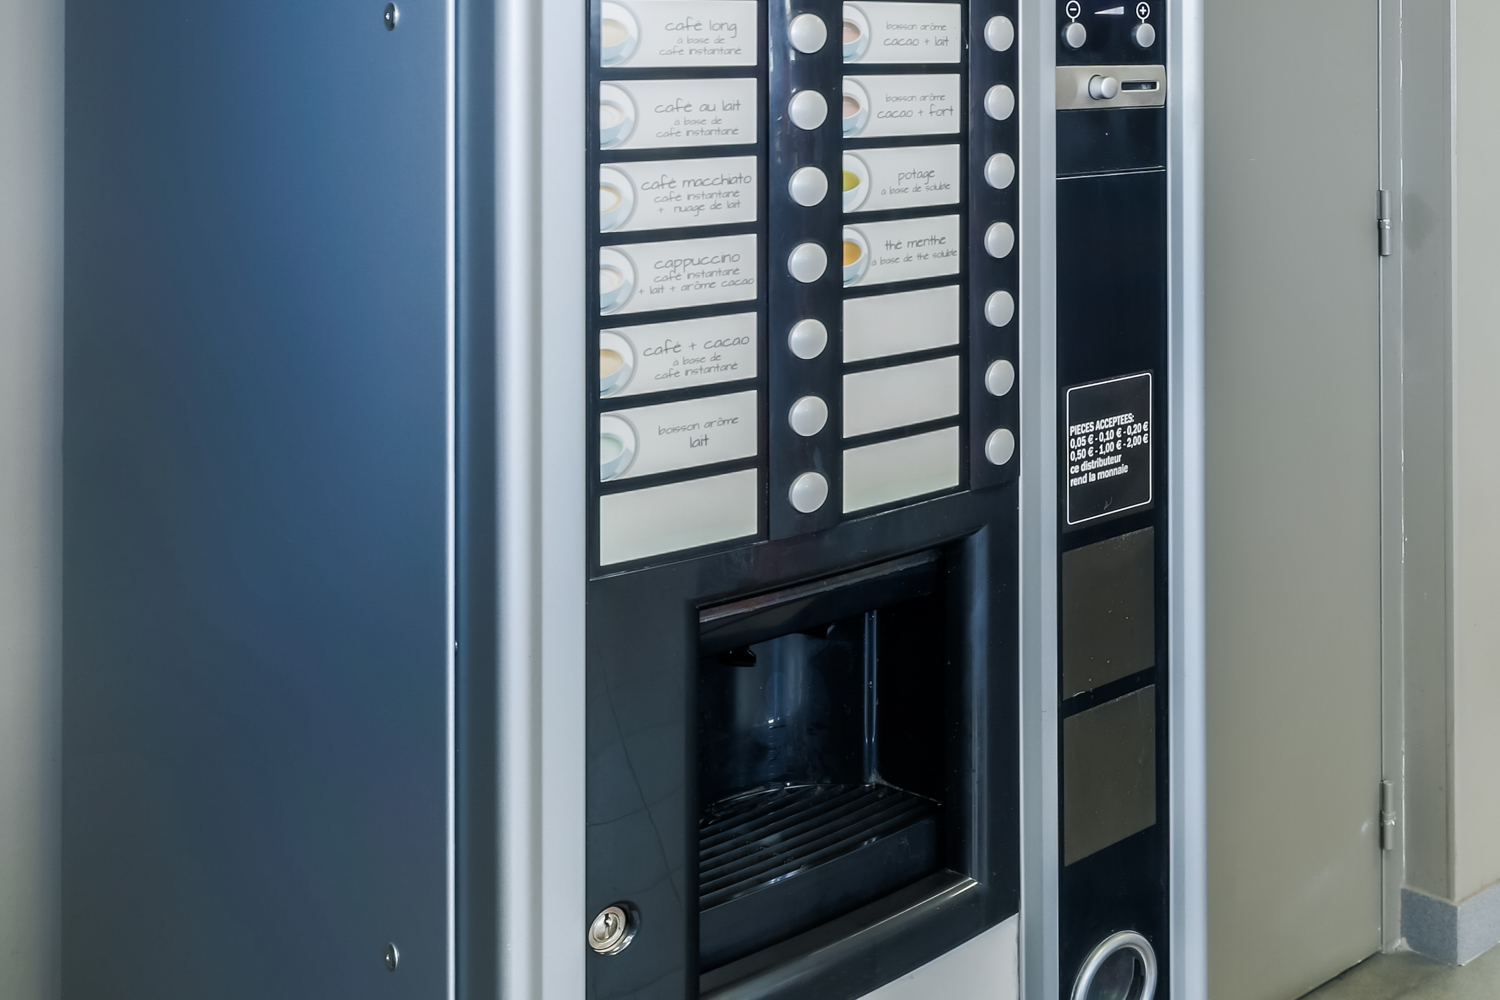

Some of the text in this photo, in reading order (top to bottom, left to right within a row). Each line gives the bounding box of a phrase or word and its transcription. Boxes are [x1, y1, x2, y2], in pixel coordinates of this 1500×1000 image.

[665, 17, 737, 38] café long
[884, 37, 919, 46] cacao
[935, 36, 949, 46] lait
[655, 98, 741, 113] café au lait
[877, 109, 913, 119] cacao
[929, 104, 954, 116] fort
[641, 173, 752, 190] café macchiato
[898, 168, 935, 186] potage
[674, 203, 705, 217] nuage
[710, 201, 722, 210] de
[727, 200, 741, 208] lait
[884, 235, 946, 250] thé menthe
[654, 252, 740, 272] cappuccino
[650, 285, 664, 295] lait
[681, 278, 716, 291] arôme
[721, 278, 754, 288] cacao
[643, 339, 682, 356] café
[704, 336, 750, 349] cacao
[658, 416, 739, 435] boisson arôme
[1070, 413, 1134, 436] PIECES ACCEPTEES:
[689, 434, 709, 448] lait
[1070, 436, 1086, 449] 0,05
[1088, 434, 1094, 445] €
[1099, 430, 1114, 443] 0,10
[1116, 427, 1122, 438] €
[1127, 423, 1142, 436] 0,20
[1143, 421, 1148, 432] €
[1070, 449, 1086, 462] 0,50
[1088, 447, 1094, 457] €
[1099, 442, 1114, 455] 1,00
[1116, 440, 1122, 450] €
[1127, 435, 1142, 449] 2,00
[1143, 433, 1148, 444] €
[1070, 454, 1122, 474] ce distributeur
[1070, 464, 1128, 487] rend la monnaie
